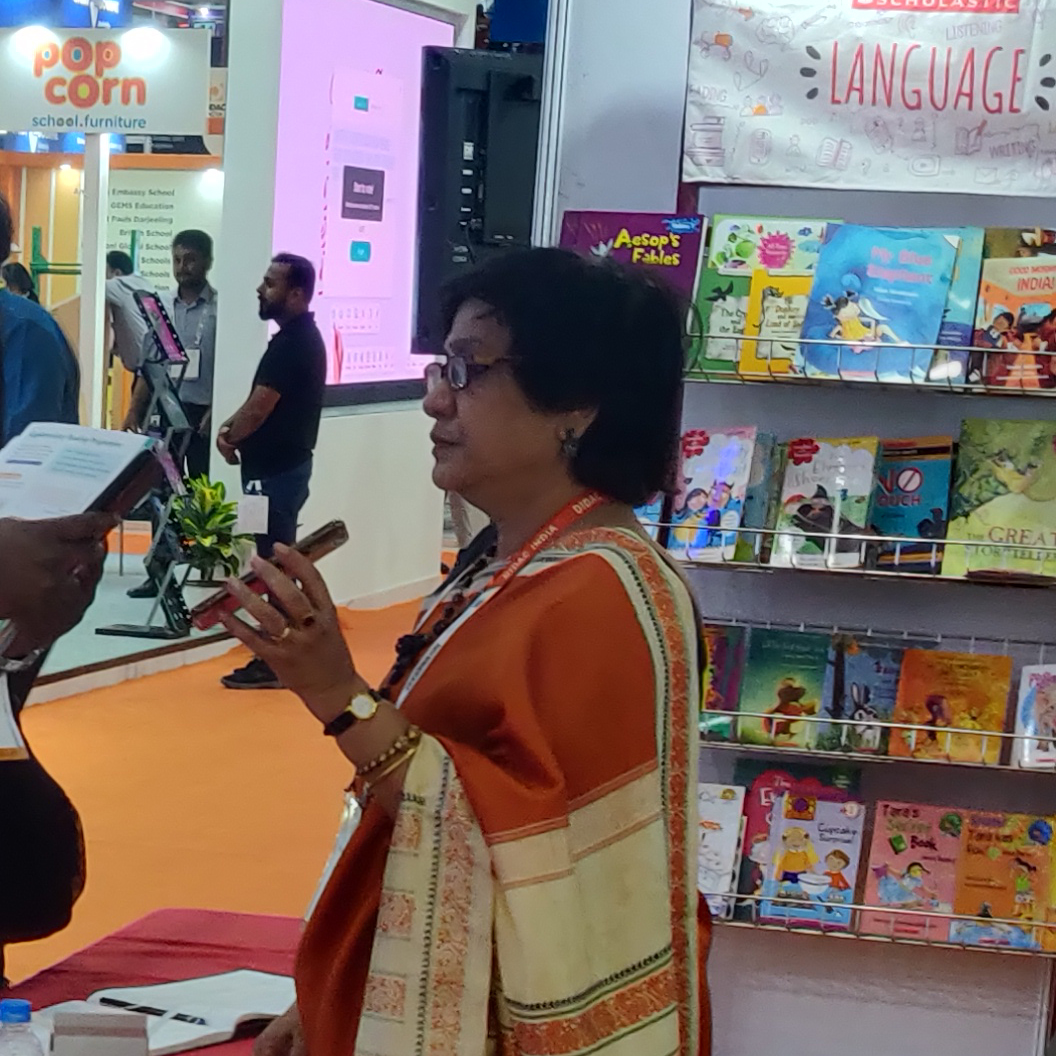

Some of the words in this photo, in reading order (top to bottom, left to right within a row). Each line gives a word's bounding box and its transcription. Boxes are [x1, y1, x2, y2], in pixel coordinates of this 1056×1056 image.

[830, 39, 1026, 115] LANGUAGE
[31, 114, 147, 129] school.furniture
[148, 188, 175, 197] School
[134, 202, 174, 210] Education
[133, 216, 173, 225] Darjeeling
[146, 229, 173, 237] School
[613, 228, 681, 251] Aesop's
[632, 247, 680, 266] Fables
